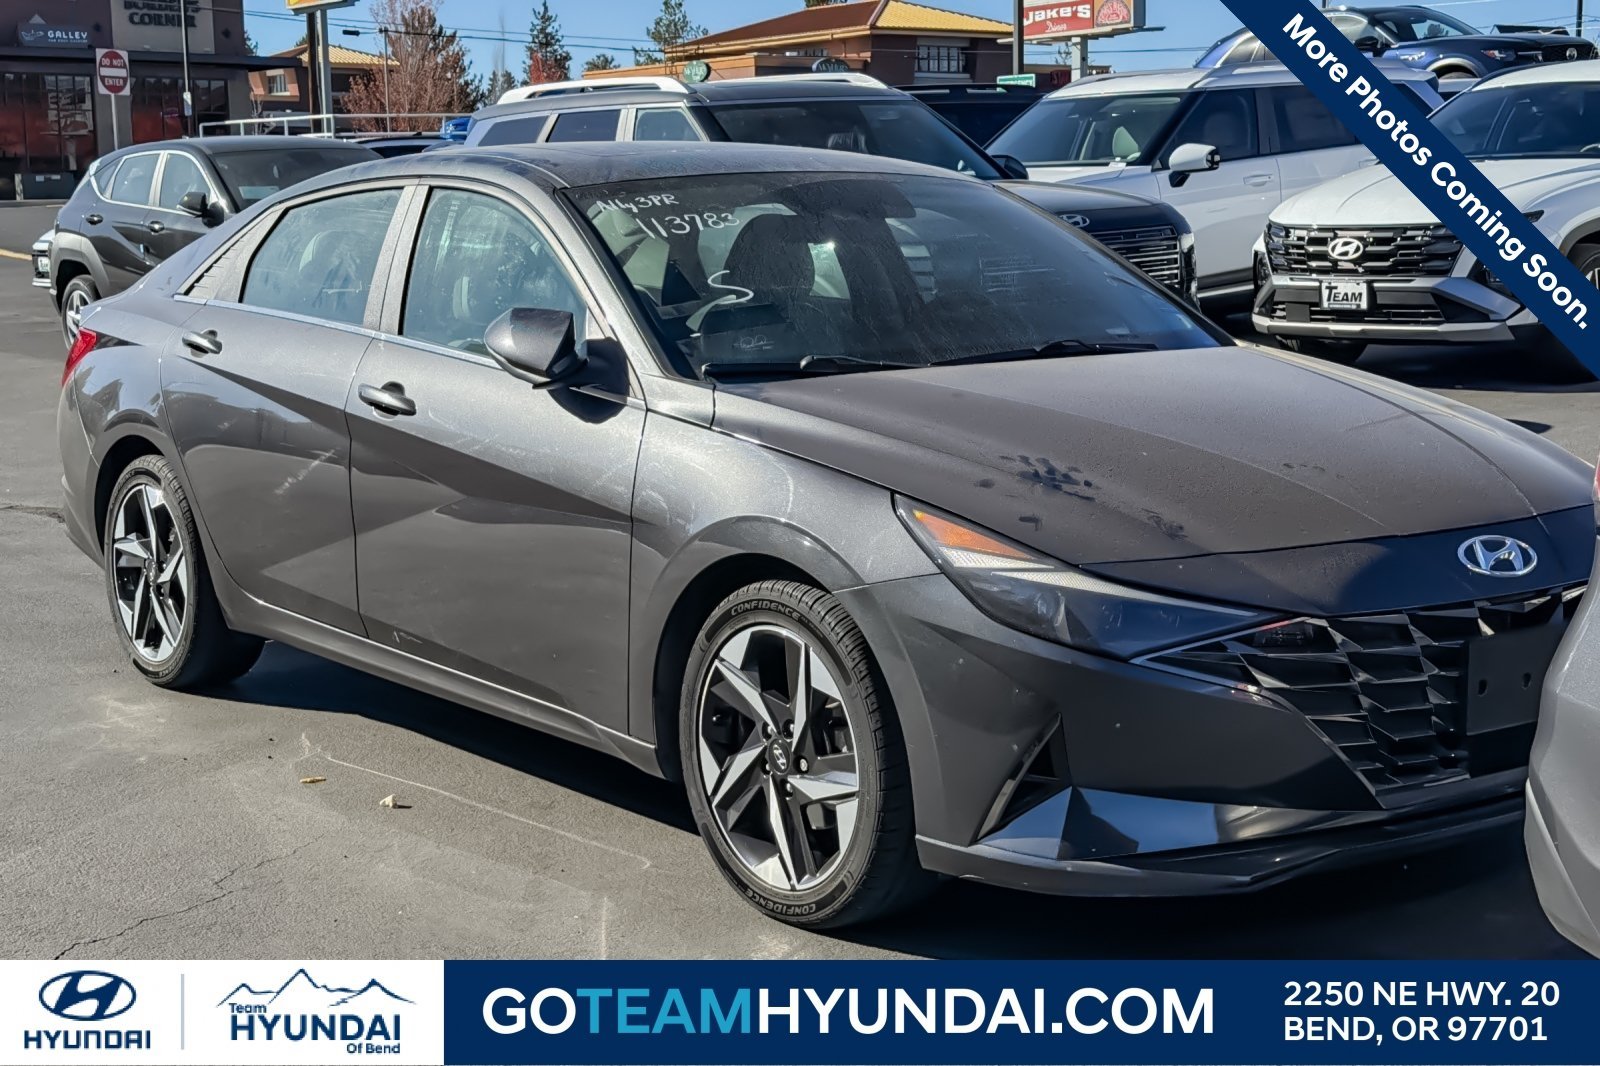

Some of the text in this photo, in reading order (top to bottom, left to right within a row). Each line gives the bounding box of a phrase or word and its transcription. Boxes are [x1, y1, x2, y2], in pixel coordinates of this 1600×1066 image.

[47, 30, 88, 39] GALLEY
[101, 58, 124, 67] DO NOT
[105, 78, 124, 87] ENTER
[635, 212, 740, 239] 113783
[731, 600, 801, 621] CONFIDENCE
[745, 888, 816, 916] CONFIDENCE
